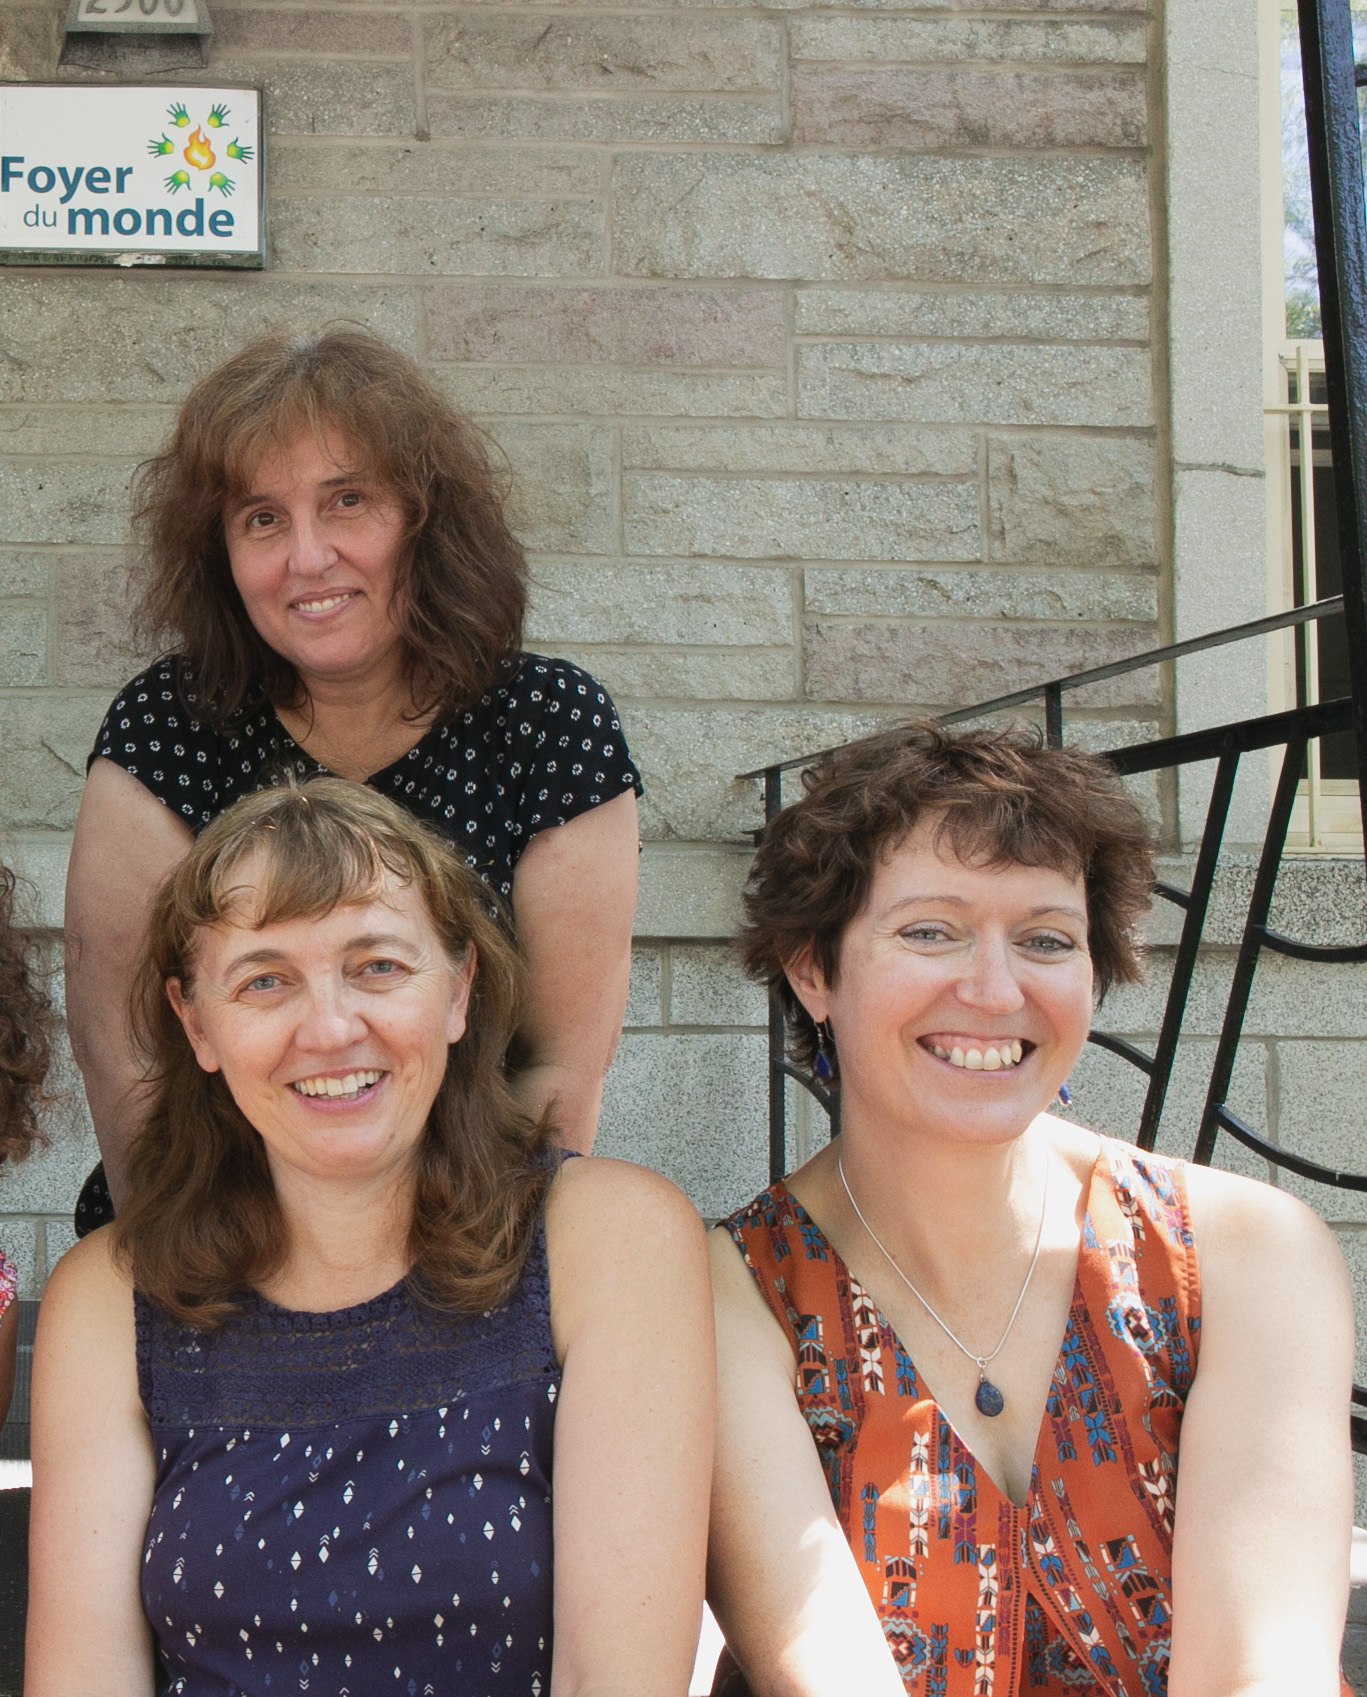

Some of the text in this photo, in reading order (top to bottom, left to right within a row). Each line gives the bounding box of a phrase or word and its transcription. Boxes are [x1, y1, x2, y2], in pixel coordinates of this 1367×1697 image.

[1, 156, 133, 205] Foyer
[23, 198, 235, 237] du monde
